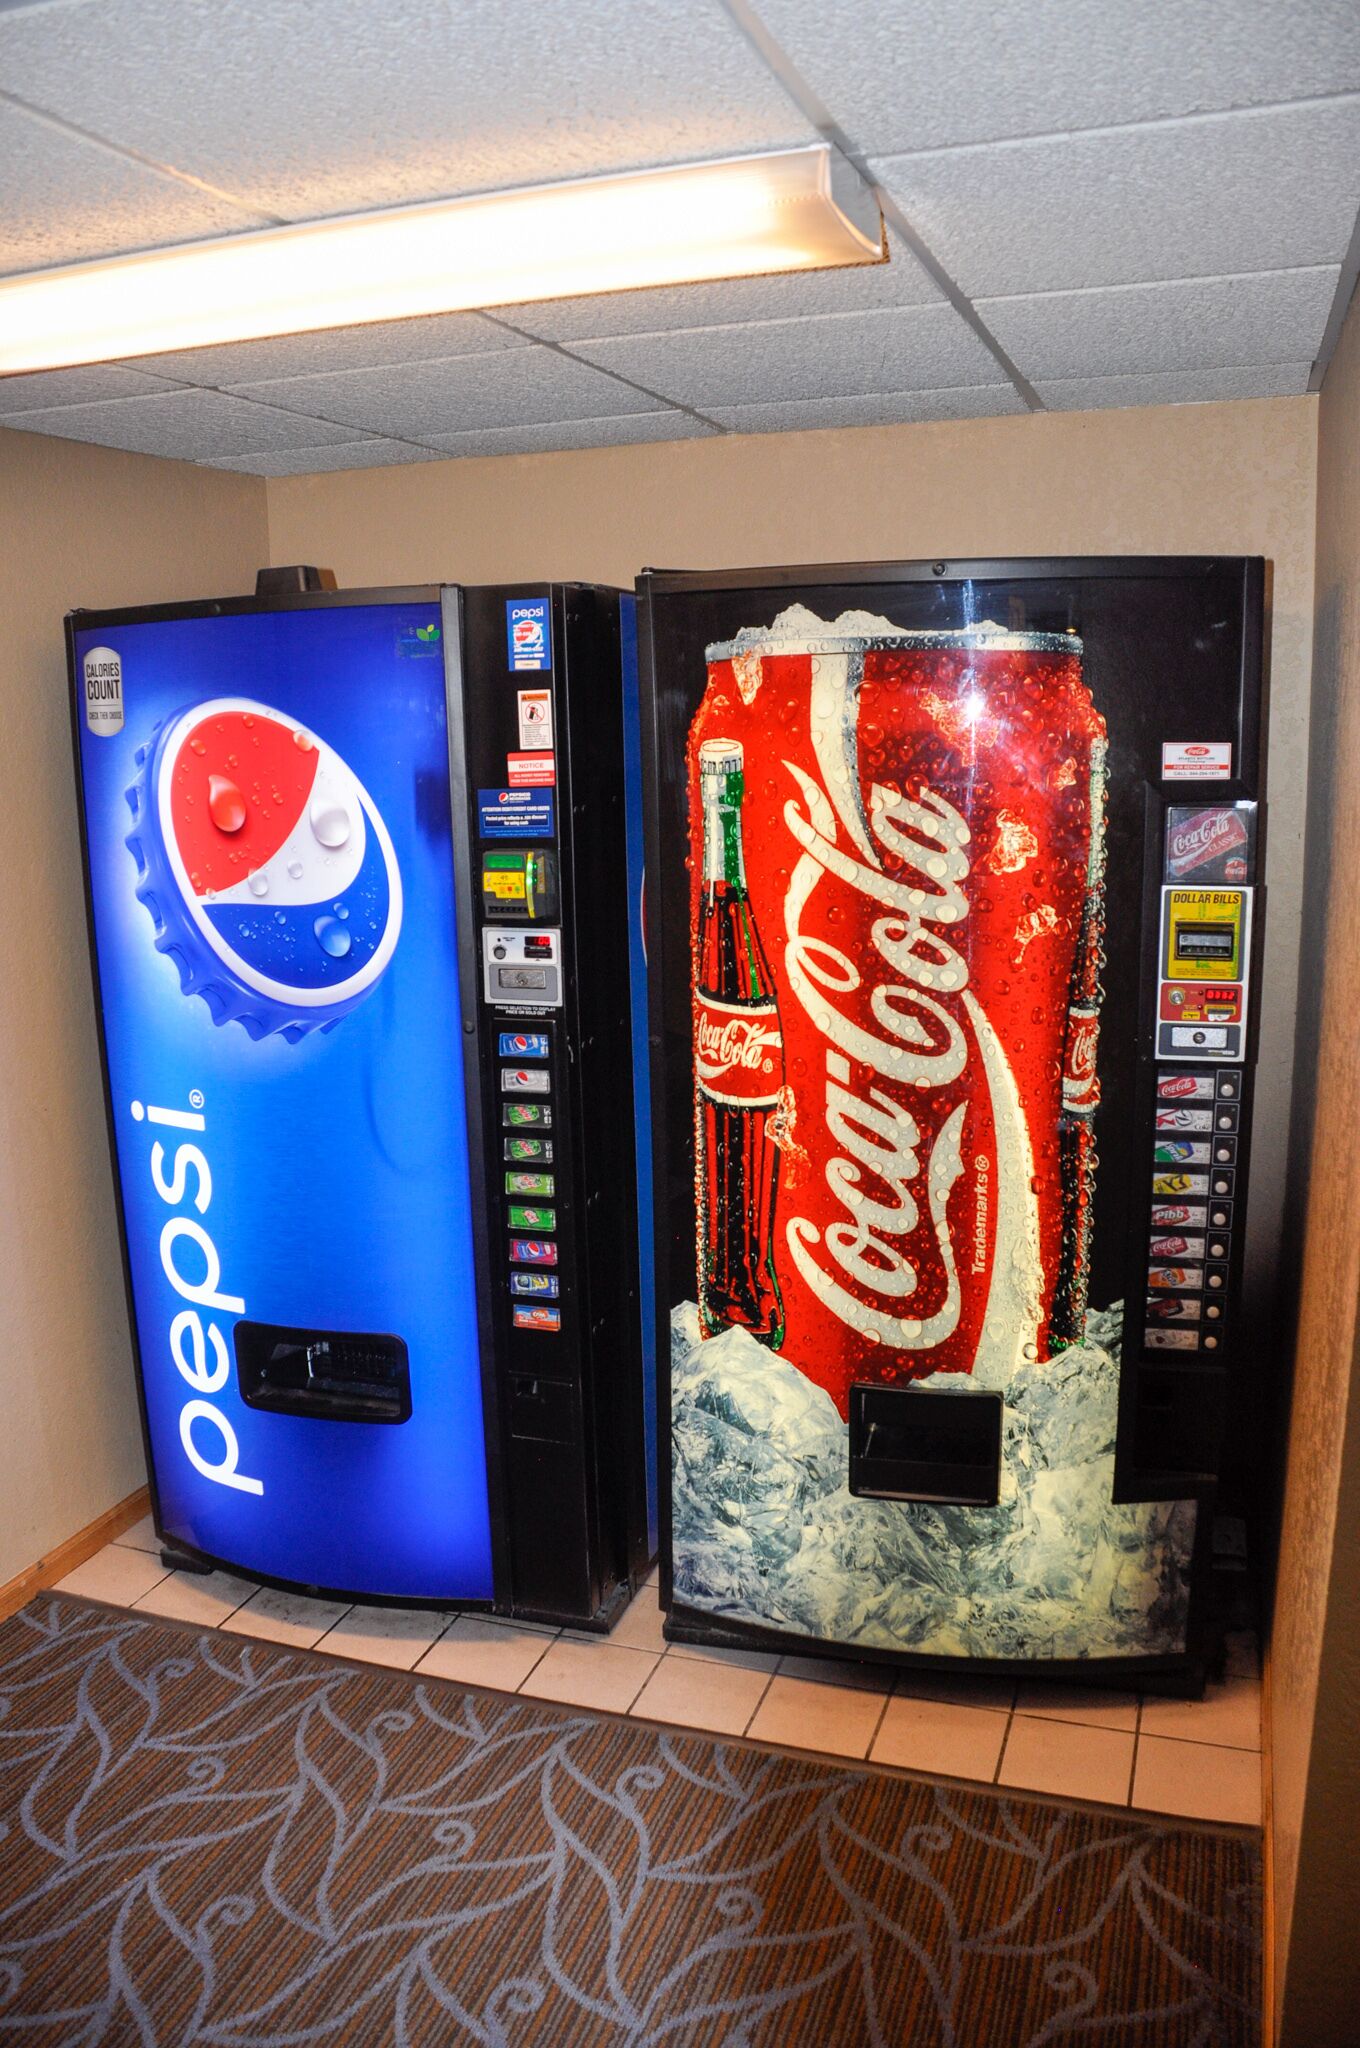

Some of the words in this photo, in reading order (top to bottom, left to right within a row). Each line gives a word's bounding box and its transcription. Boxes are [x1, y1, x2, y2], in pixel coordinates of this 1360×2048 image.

[512, 606, 544, 620] pepsi
[86, 662, 120, 678] CALORIES
[87, 679, 120, 701] COUNT
[1173, 811, 1230, 856] Coca-Cola
[1173, 892, 1212, 904] DOLLAR
[1213, 893, 1240, 905] BILLS
[698, 1011, 767, 1070] Coca-Cola
[782, 760, 972, 1351] Coca-Cola
[1155, 1209, 1184, 1220] Pibb
